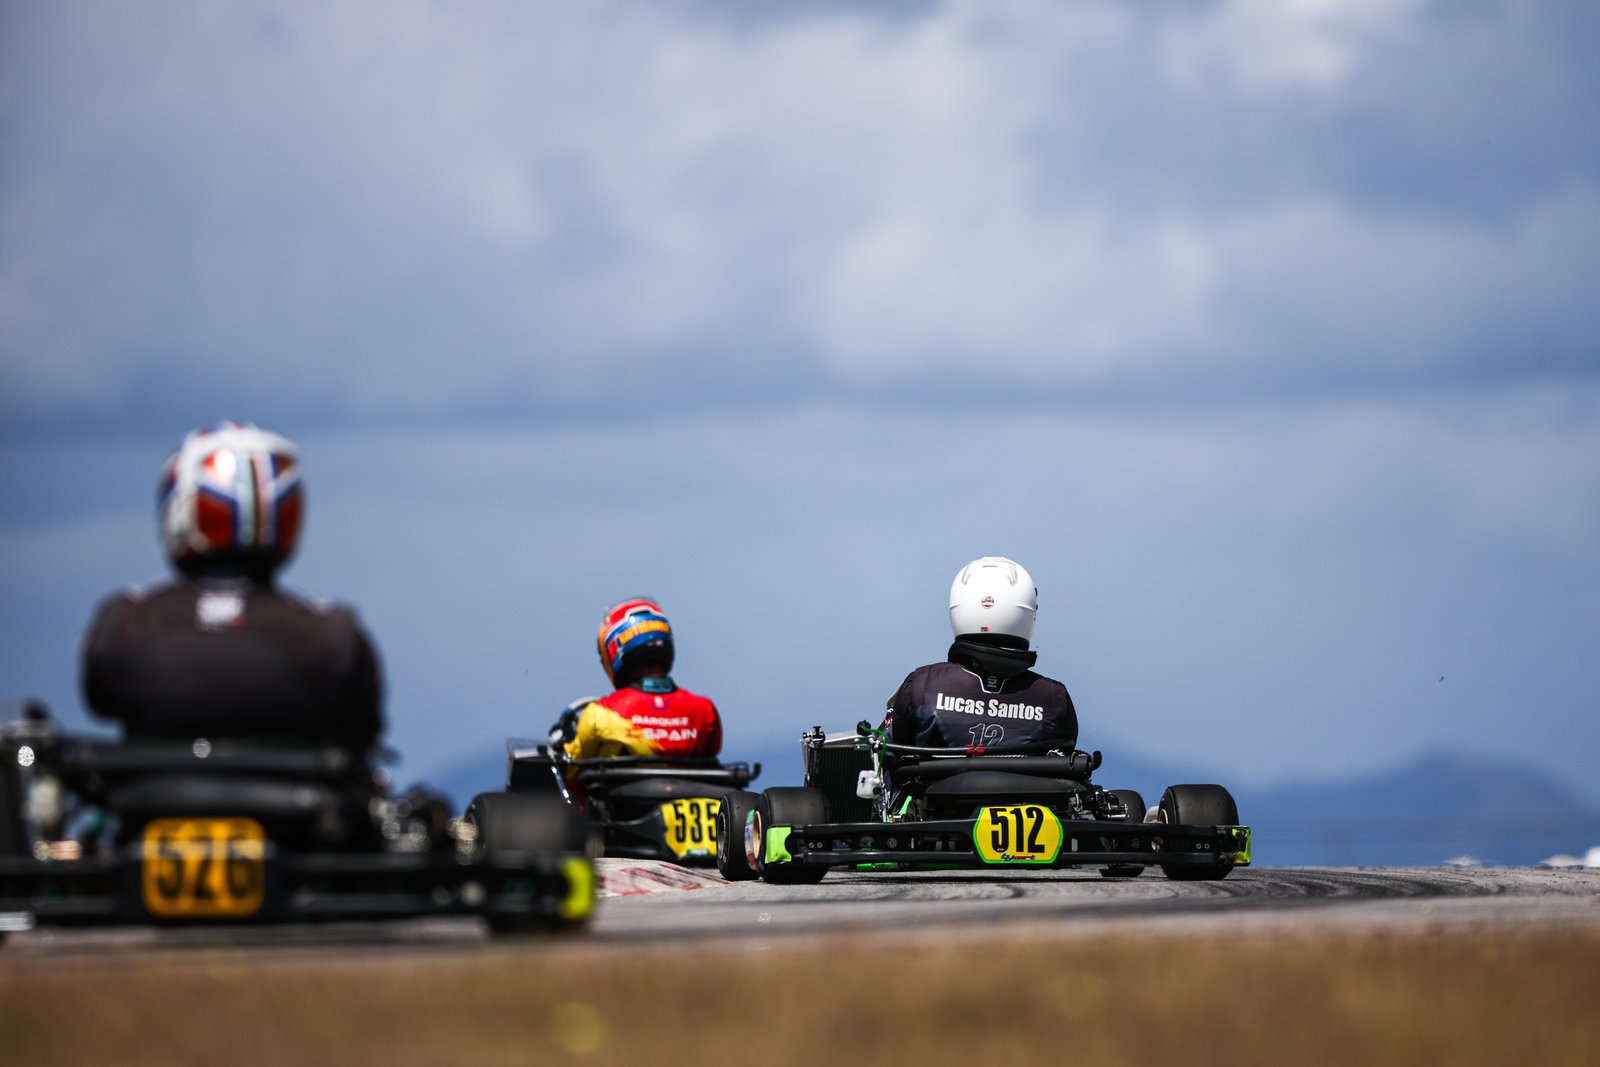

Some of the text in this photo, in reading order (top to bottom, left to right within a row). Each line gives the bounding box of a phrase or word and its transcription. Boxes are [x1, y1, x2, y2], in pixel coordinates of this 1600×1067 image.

[936, 692, 1044, 721] Lucas Santos
[631, 716, 688, 727] MARQUEZ
[641, 728, 697, 741] SPAIN
[968, 723, 1005, 746] 12
[673, 802, 718, 843] 535
[989, 806, 1045, 853] 512
